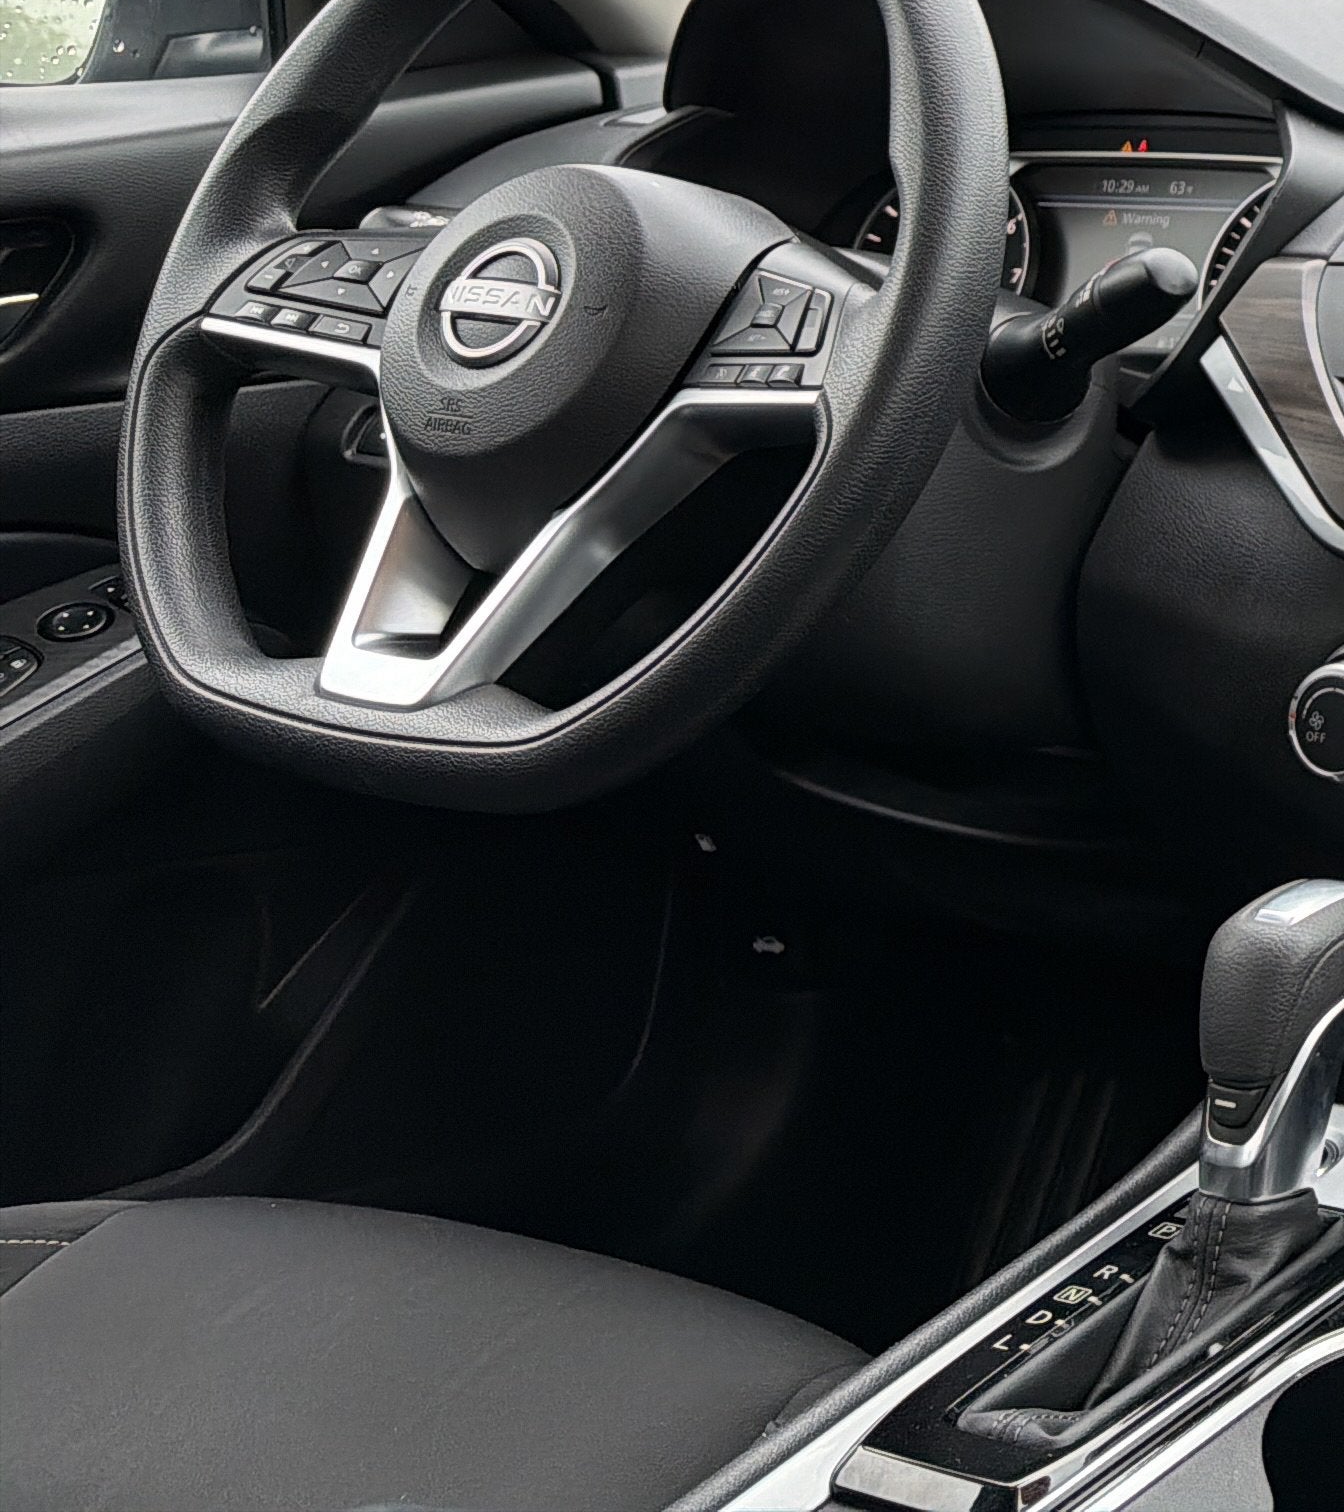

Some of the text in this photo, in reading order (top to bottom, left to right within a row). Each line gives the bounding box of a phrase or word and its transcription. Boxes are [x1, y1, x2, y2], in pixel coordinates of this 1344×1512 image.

[1102, 179, 1150, 193] 10:29 AM
[1007, 219, 1017, 234] 6
[1122, 213, 1170, 228] Warning
[1010, 268, 1022, 283] 7
[449, 284, 555, 317] NISSAN
[440, 397, 462, 412] SRS
[424, 417, 472, 434] AIRBAG
[1306, 731, 1326, 743] OFF
[1094, 1264, 1118, 1280] R
[1064, 1288, 1085, 1301] N
[1026, 1310, 1052, 1325] D
[993, 1334, 1015, 1351] L
